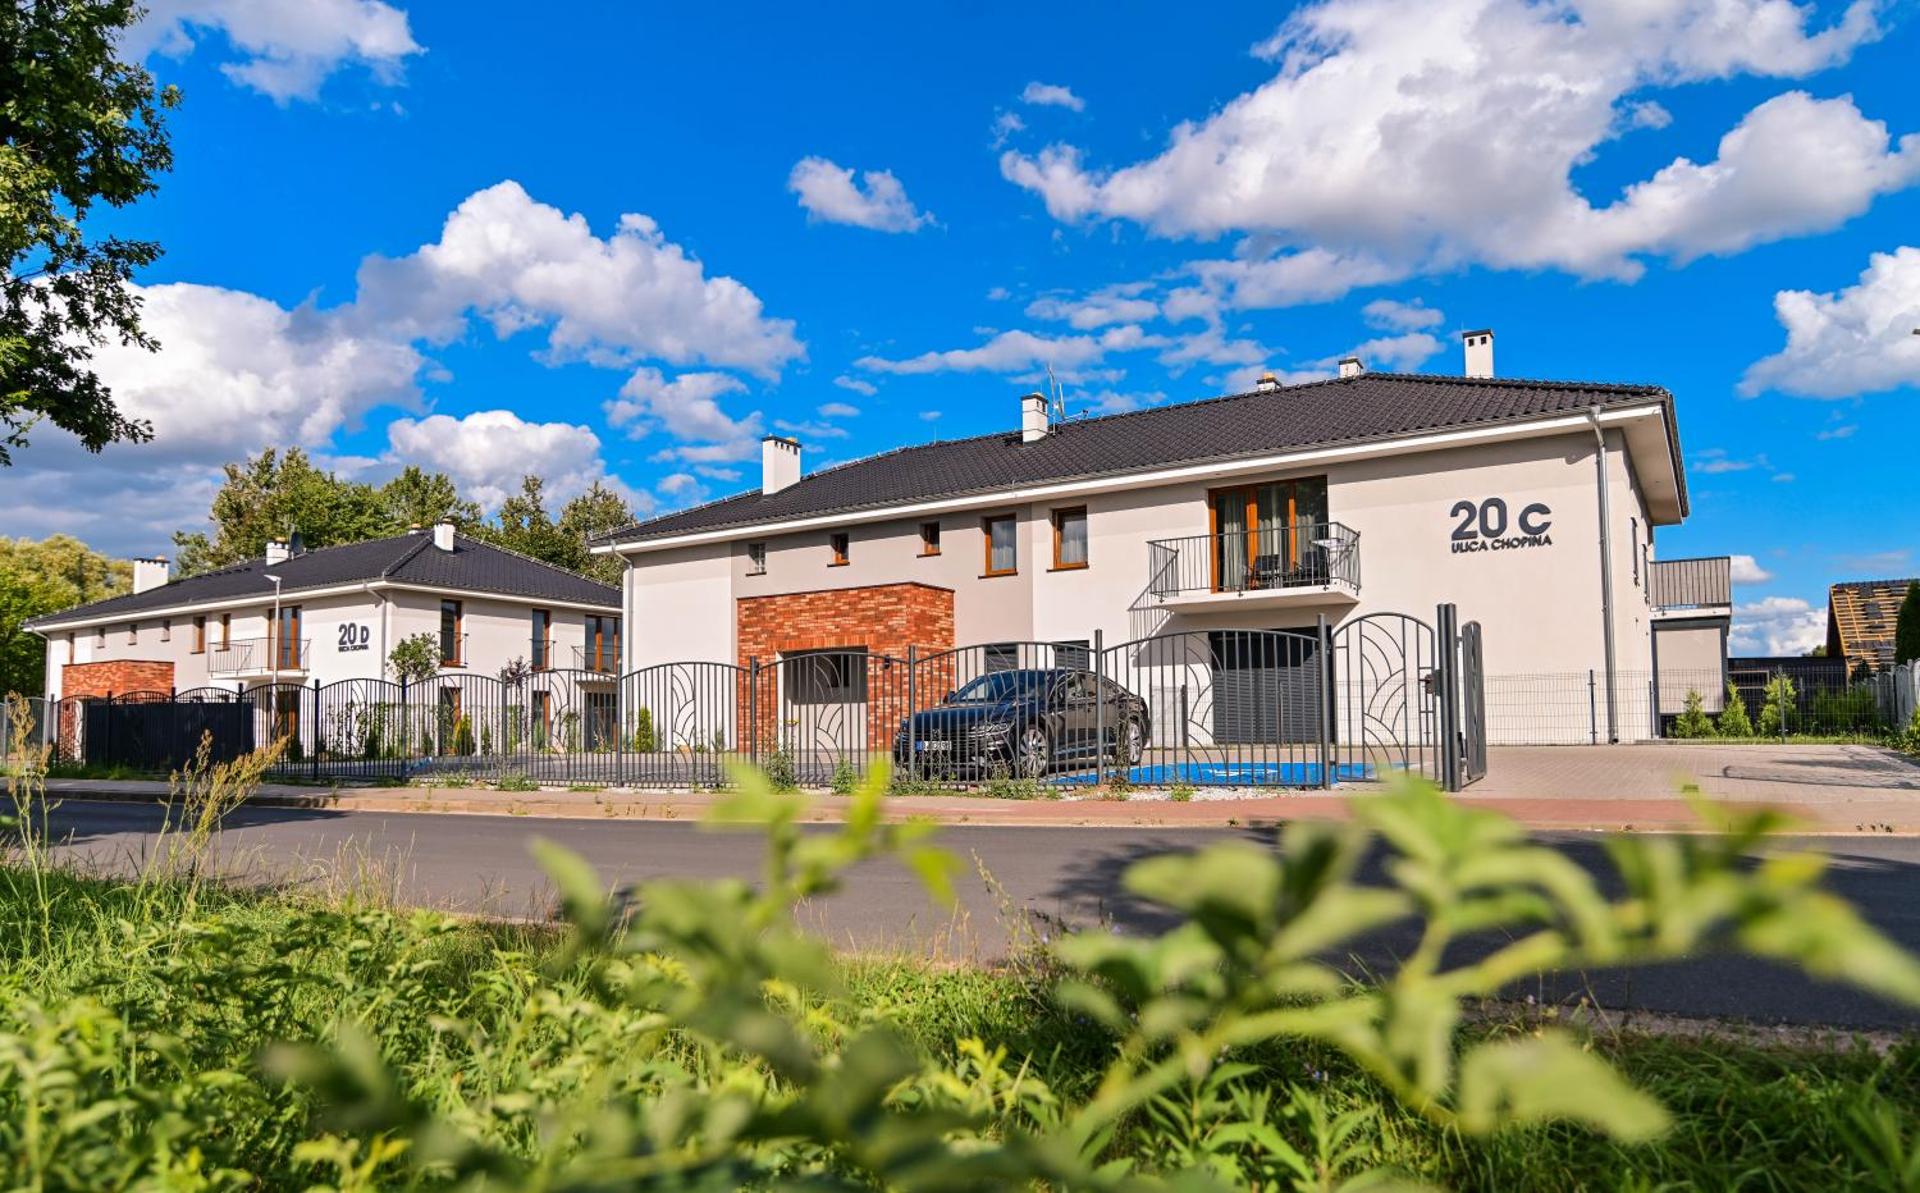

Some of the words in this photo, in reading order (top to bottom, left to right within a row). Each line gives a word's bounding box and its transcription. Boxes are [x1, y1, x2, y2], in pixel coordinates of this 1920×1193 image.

[1450, 497, 1507, 541] 20
[1518, 503, 1552, 536] C
[1451, 540, 1488, 553] ULICA
[1491, 535, 1552, 551] CHOPINA
[338, 622, 357, 645] 20
[360, 625, 370, 643] D
